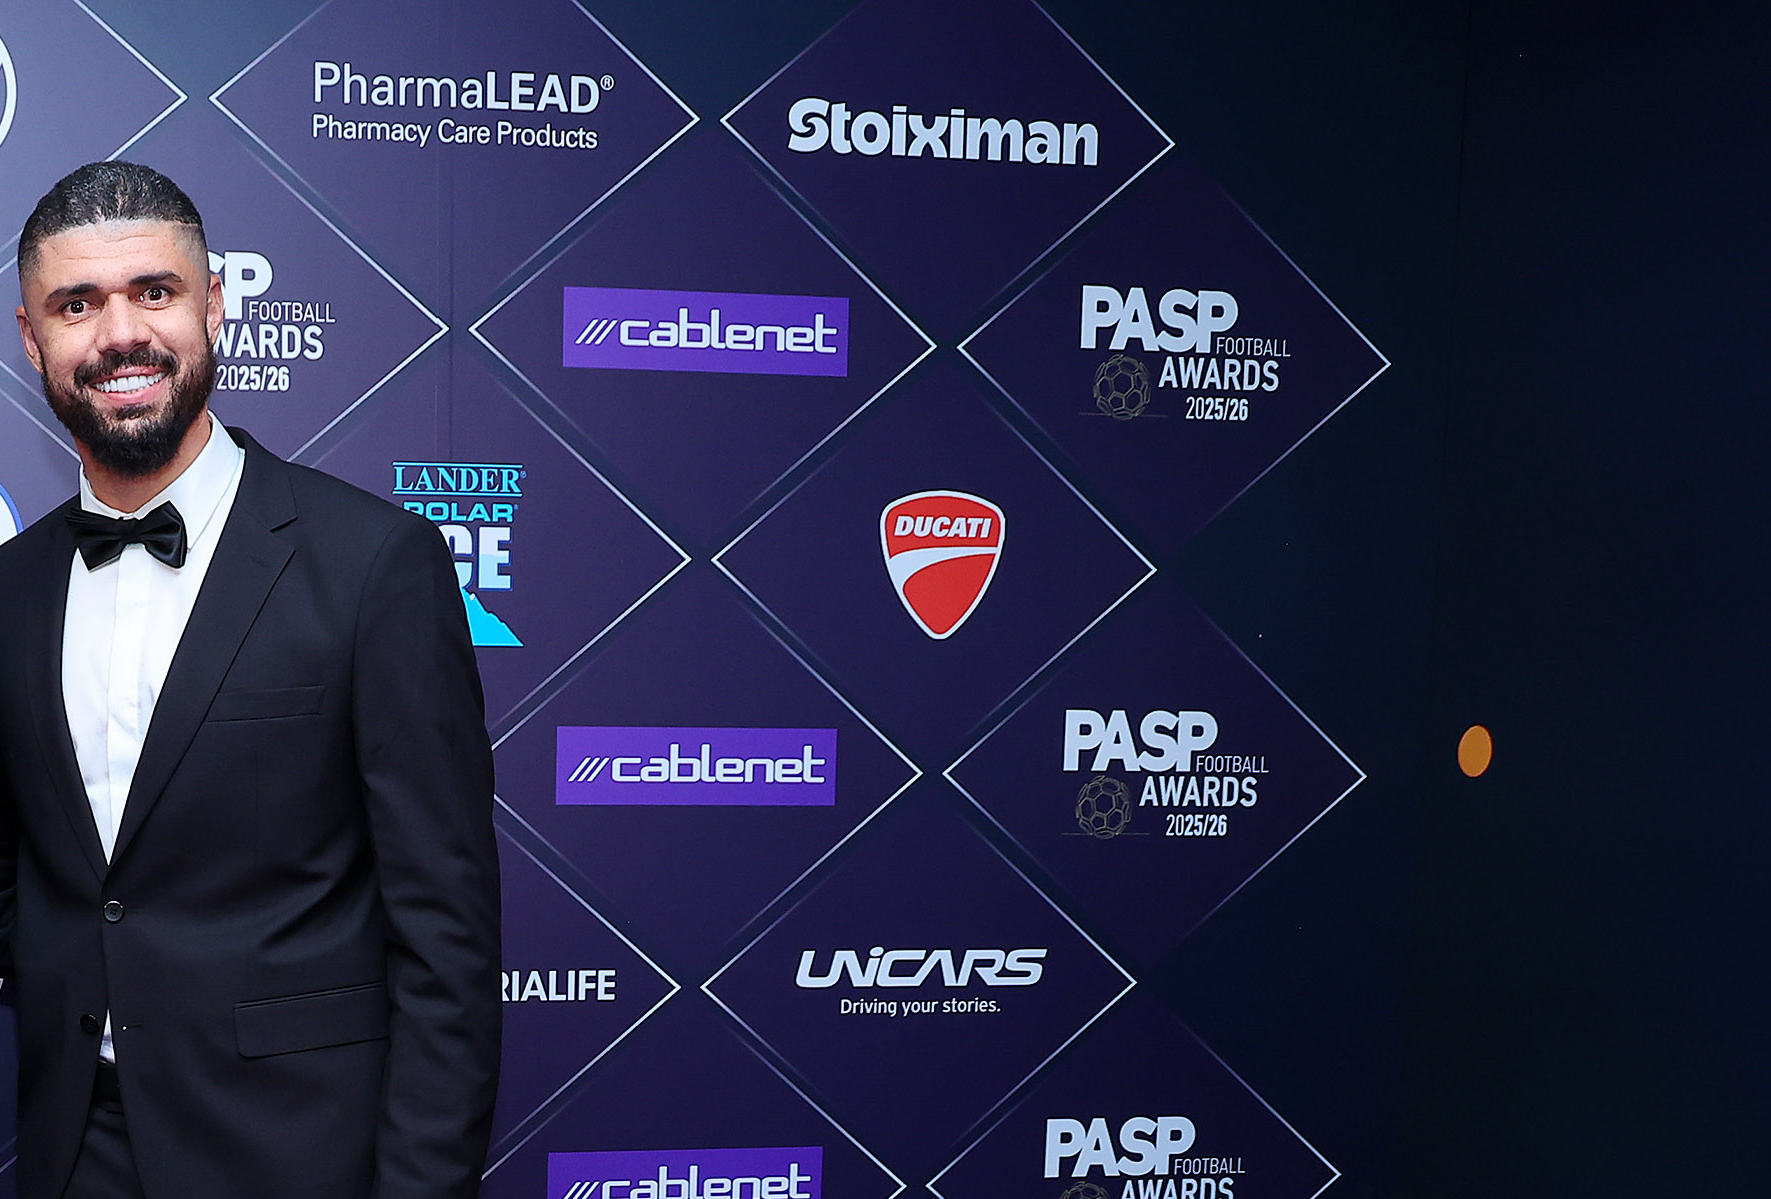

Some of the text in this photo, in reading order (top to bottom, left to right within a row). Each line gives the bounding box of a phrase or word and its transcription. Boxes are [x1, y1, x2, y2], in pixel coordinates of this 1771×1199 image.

[312, 113, 598, 149] Pharmacy Care Products
[787, 97, 1099, 166] Stoiximan
[248, 300, 336, 323] FOOTBALL
[1080, 284, 1239, 355] PASP
[213, 323, 324, 360] WARDS
[619, 307, 838, 353] cablenet
[1216, 336, 1291, 358] FOOTBALL
[216, 365, 290, 391] 2025/26
[1158, 355, 1280, 392] AWARDS
[1185, 396, 1249, 421] 2025/26
[894, 515, 992, 539] DUCATI
[438, 524, 511, 589] CE
[1062, 709, 1219, 773] PASP
[611, 743, 826, 783] cablenet
[1195, 755, 1270, 774] FOOTBALL
[1138, 775, 1258, 807] AWARDS
[1165, 813, 1228, 837] 2025/26
[502, 970, 616, 1001] IALIFE
[840, 996, 1001, 1018] Driving your stories.
[1043, 1116, 1196, 1179] PASP
[1173, 1157, 1246, 1175] FOOTBALL
